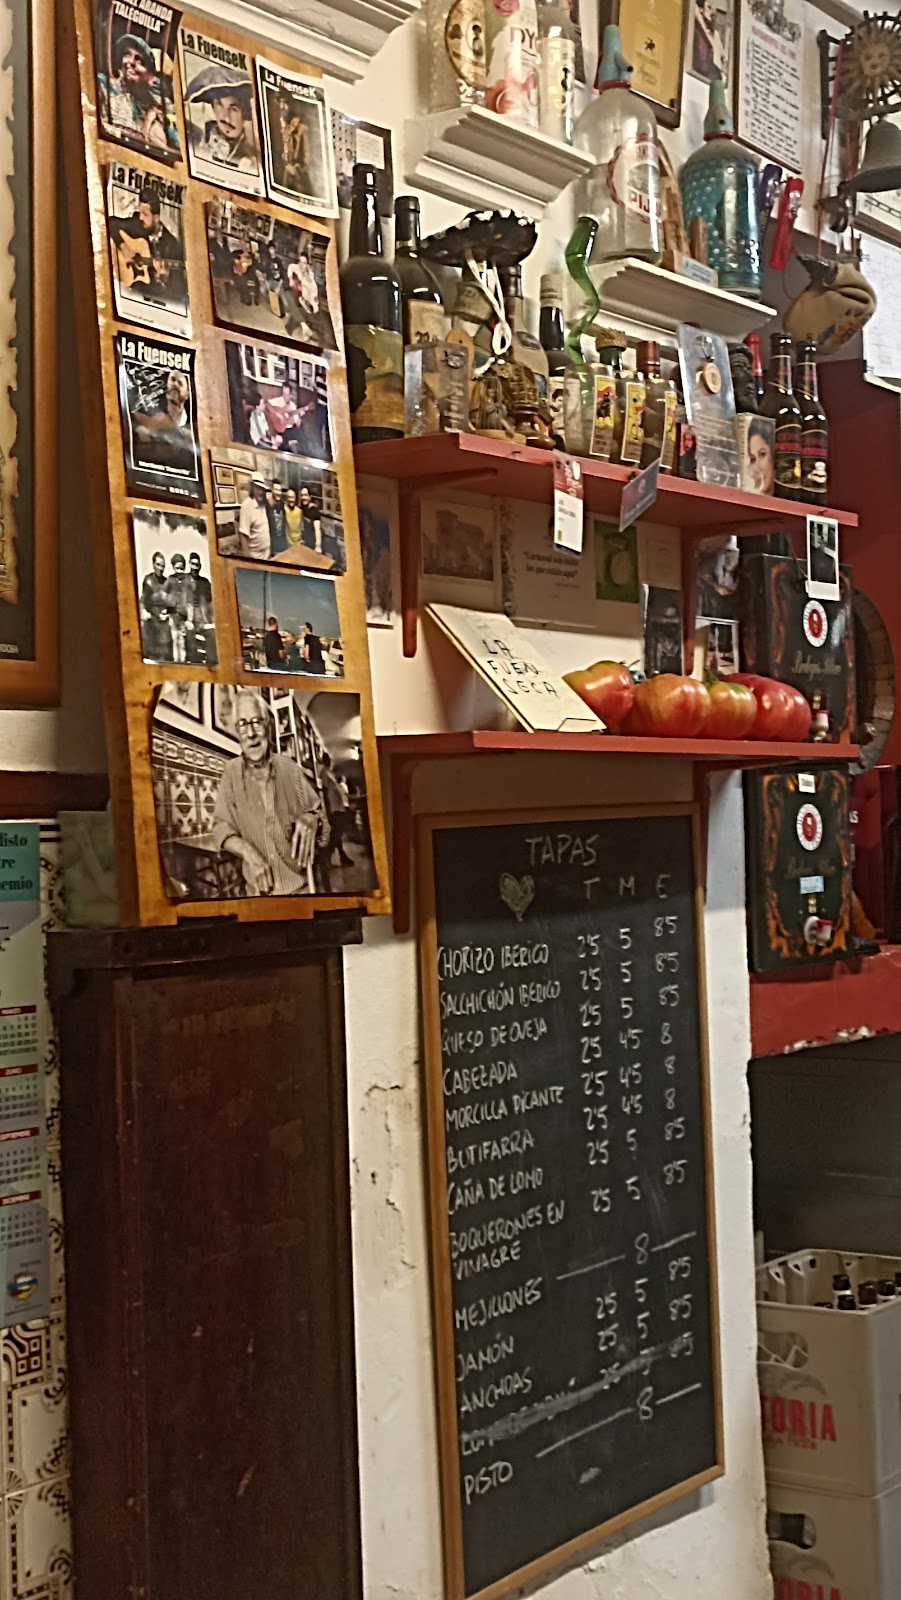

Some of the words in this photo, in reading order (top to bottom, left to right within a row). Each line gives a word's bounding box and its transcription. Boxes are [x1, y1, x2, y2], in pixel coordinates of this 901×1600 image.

[139, 0, 174, 23] ARANDA
[180, 28, 195, 49] La
[265, 70, 275, 82] La
[112, 161, 125, 184] La
[121, 337, 135, 358] La
[482, 638, 516, 660] LA
[502, 677, 560, 699] SECA
[525, 834, 600, 867] TAPAS
[584, 877, 600, 899] T
[618, 875, 635, 897] M
[655, 873, 672, 899] E
[619, 928, 632, 949] 5
[437, 942, 494, 980] CHORIZO
[621, 961, 632, 983] 5
[621, 997, 633, 1019] 5
[490, 1025, 506, 1047] DE
[509, 1017, 548, 1041] OVEJA
[660, 1022, 672, 1044] 8
[664, 1055, 676, 1075] 8
[443, 1061, 518, 1096] CABEZADA
[445, 1099, 508, 1132] MORCILLA
[512, 1086, 564, 1114] PICANTE
[664, 1088, 676, 1110] 8
[447, 1128, 535, 1173] BUTIFARRA
[626, 1128, 638, 1151] 5
[446, 1178, 485, 1215] CAÑA
[489, 1174, 505, 1200] DE
[510, 1168, 543, 1194] LOMO
[625, 1175, 641, 1200] 5
[449, 1204, 543, 1259] BOQUERONES
[547, 1200, 565, 1225] EN
[453, 1240, 521, 1280] VINAGRE
[635, 1232, 649, 1265] 8
[635, 1277, 649, 1303] 5
[455, 1276, 543, 1331] MEJILLONES
[637, 1312, 650, 1339] 5
[457, 1332, 514, 1382] JAMÓN
[460, 1366, 532, 1418] ANCHOAS
[637, 1386, 654, 1421] 8
[761, 1394, 837, 1442] ORIA
[464, 1460, 514, 1505] PISTO
